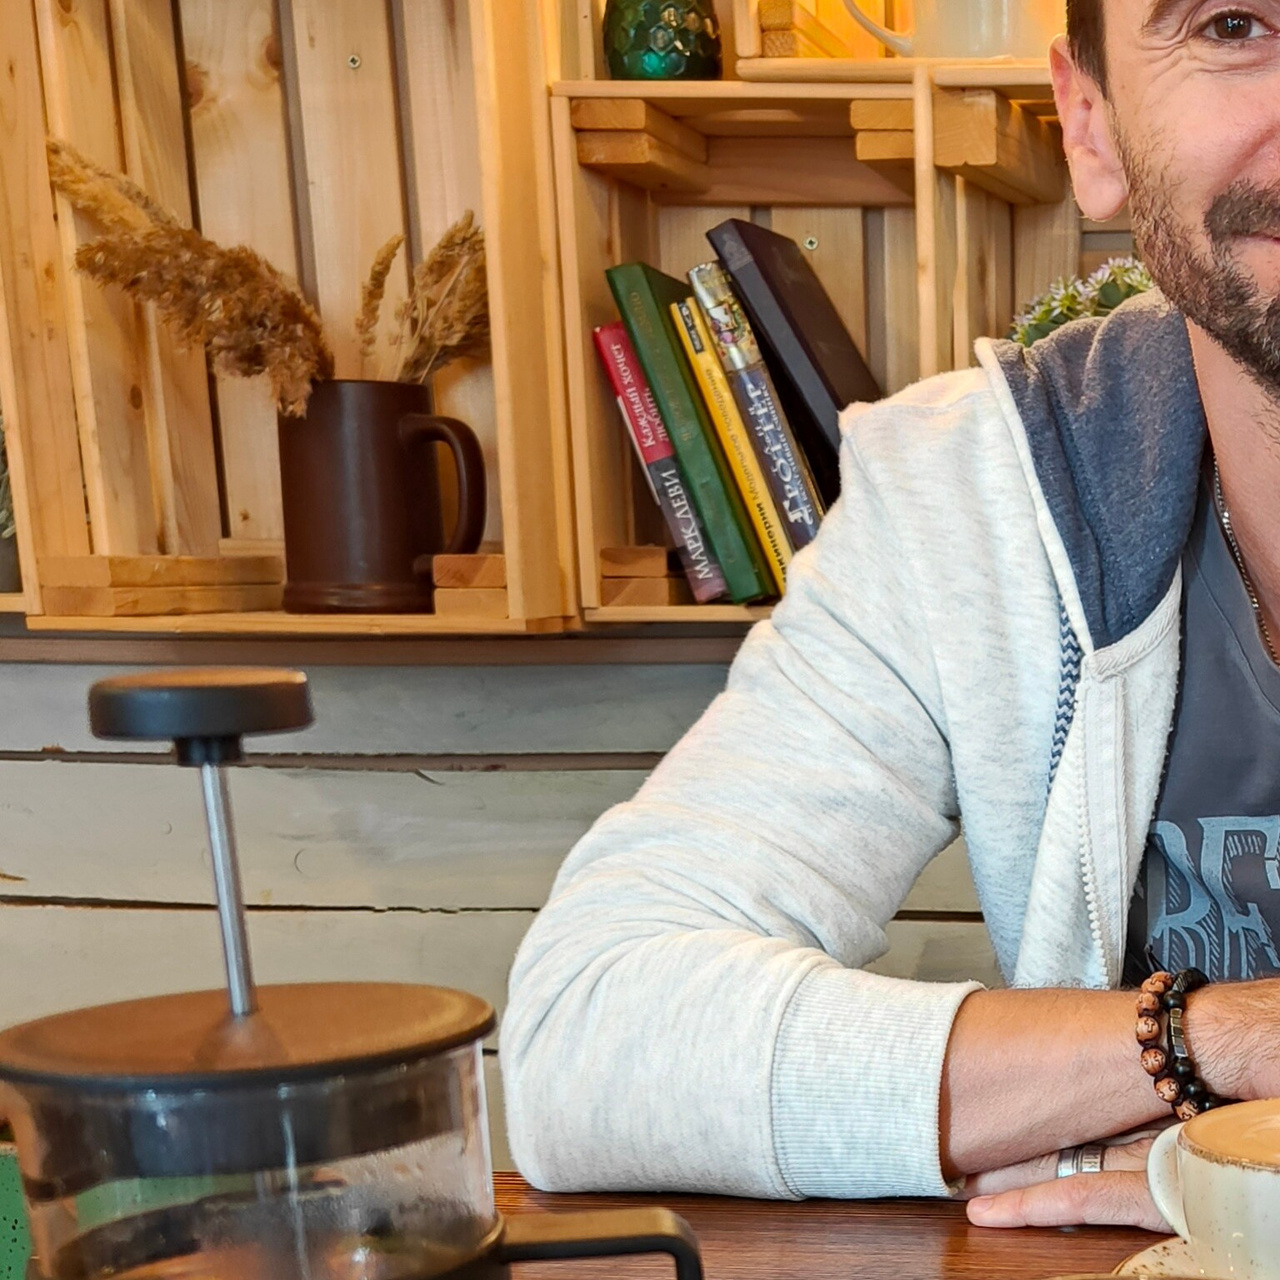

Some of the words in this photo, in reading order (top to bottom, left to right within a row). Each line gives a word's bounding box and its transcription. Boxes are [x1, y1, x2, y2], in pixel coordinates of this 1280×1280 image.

[611, 343, 633, 384] хочет
[624, 386, 656, 446] Каждый
[705, 368, 733, 431] поведение
[745, 381, 813, 525] ГРОТТЕР
[659, 468, 691, 519] ЛЕВИ
[681, 520, 713, 579] МАРК
